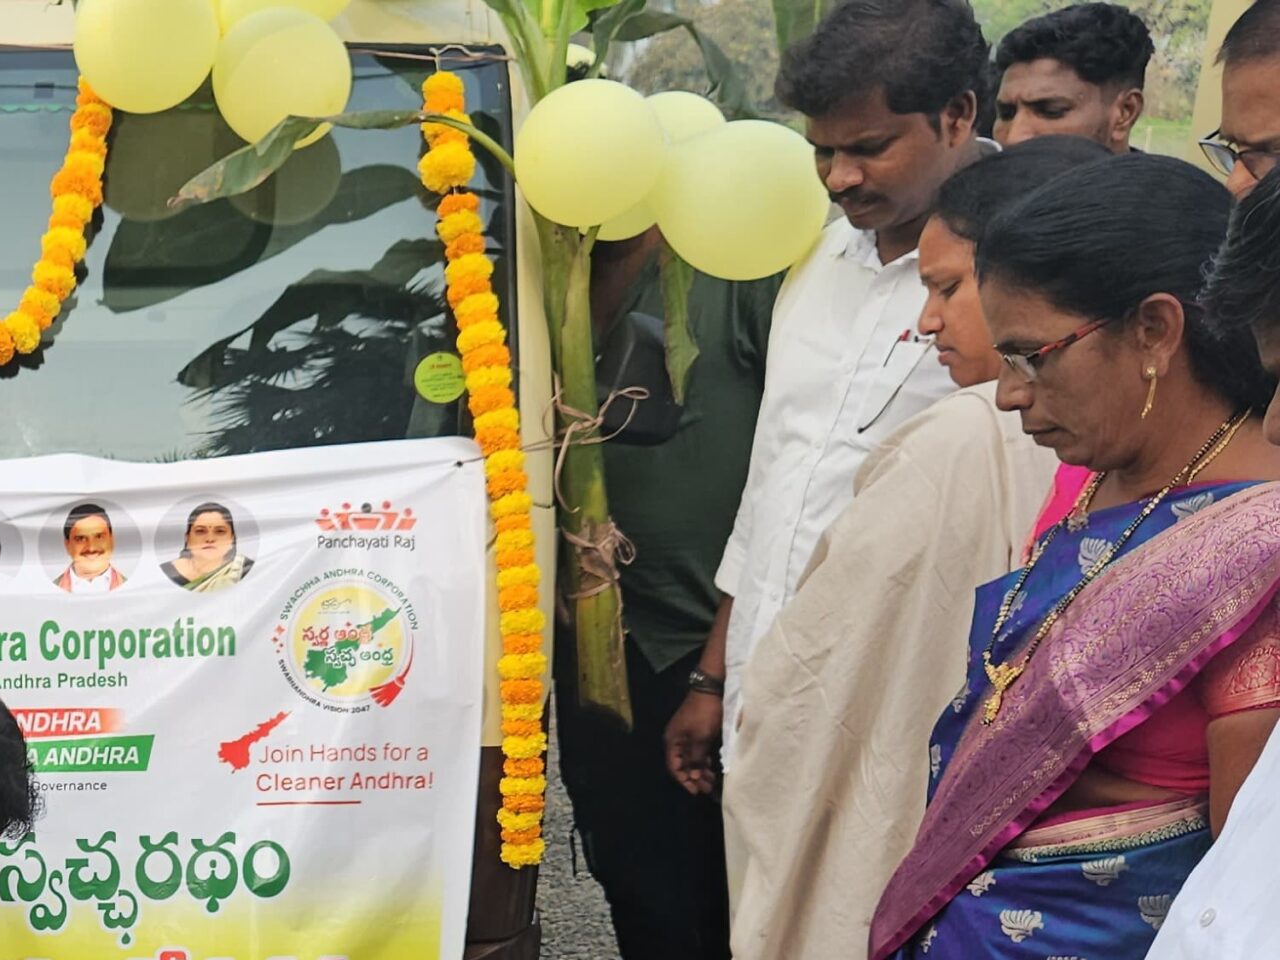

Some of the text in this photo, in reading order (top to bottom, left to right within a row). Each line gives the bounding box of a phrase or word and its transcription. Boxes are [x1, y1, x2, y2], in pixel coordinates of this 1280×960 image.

[317, 535, 416, 551] Panchayati Raj
[280, 568, 418, 630] SWACHHA ANDHRA CORPORATION
[39, 617, 236, 669] Corporation
[58, 672, 128, 688] Pradesh
[323, 703, 349, 714] VISION
[351, 704, 371, 714] 2047
[15, 711, 102, 733] NDHRA
[43, 746, 139, 766] ANDHRA
[259, 743, 429, 763] Join Hands for a
[256, 772, 434, 791] Cleaner Andhra!
